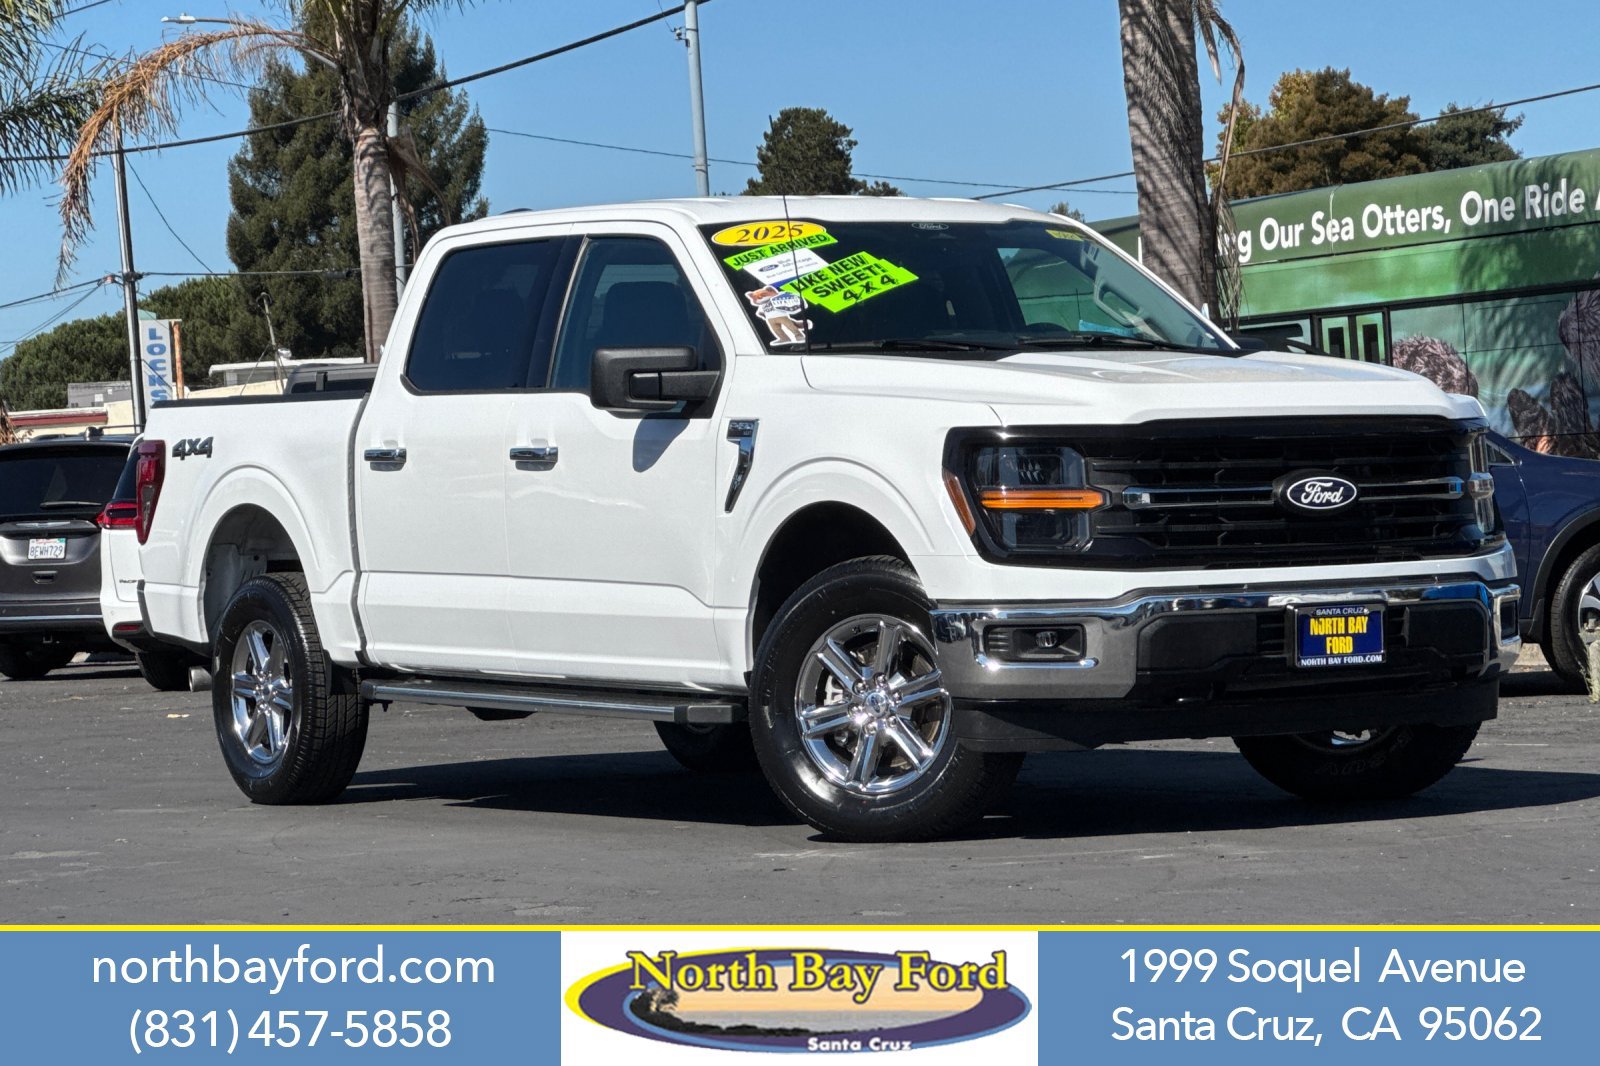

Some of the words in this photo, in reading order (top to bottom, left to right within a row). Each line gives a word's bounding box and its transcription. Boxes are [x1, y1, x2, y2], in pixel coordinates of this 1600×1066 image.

[1259, 217, 1304, 250] Our
[1311, 210, 1354, 245] Sea
[1362, 203, 1451, 238] Otters,
[1460, 190, 1515, 226] One
[1525, 177, 1585, 219] Ride
[735, 223, 804, 243] 2025
[732, 249, 768, 267] JUST
[769, 233, 831, 254] ARRIVED
[790, 268, 826, 291] LIKE
[828, 254, 868, 276] NEW
[812, 262, 888, 298] SWEET!
[1301, 481, 1344, 504] Ford
[1316, 607, 1342, 616] SANTA
[1342, 607, 1364, 615] CRUZ
[1310, 616, 1346, 636] NORTH
[1347, 615, 1369, 634] BAY
[1325, 636, 1353, 655] FORD
[1301, 657, 1327, 667] NORTH
[1328, 656, 1342, 665] BAY
[1343, 654, 1383, 664] FORD.COM
